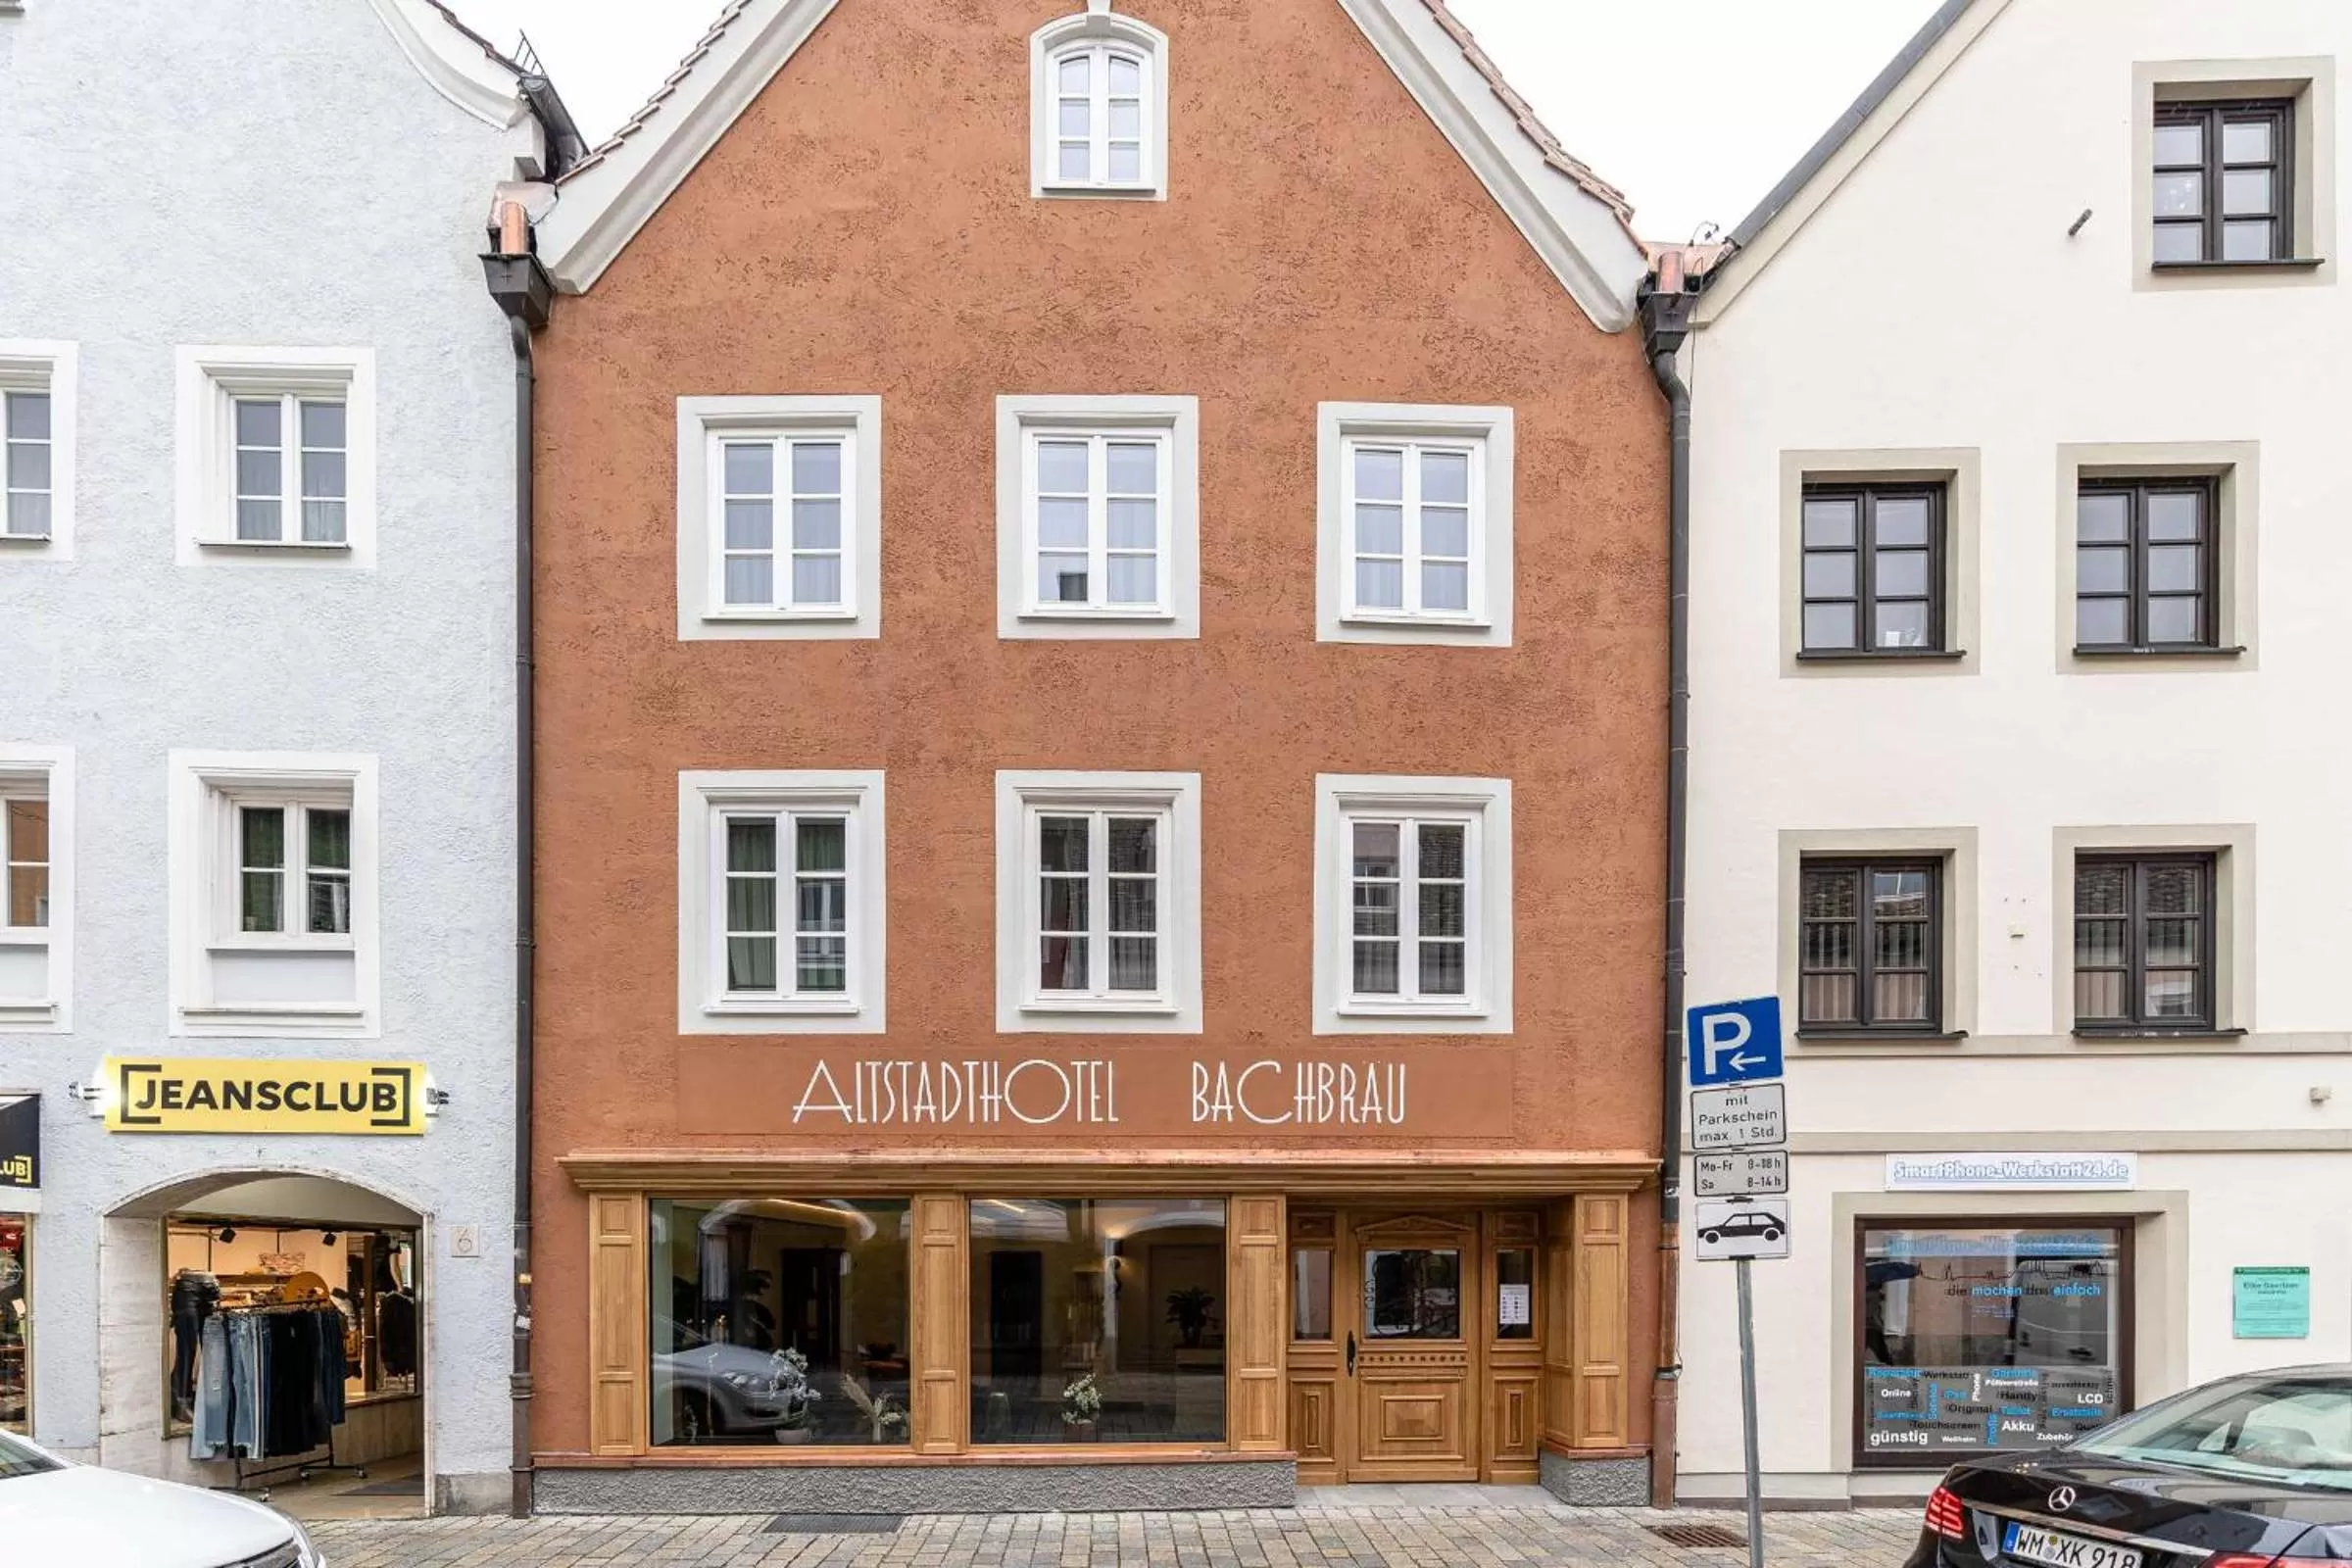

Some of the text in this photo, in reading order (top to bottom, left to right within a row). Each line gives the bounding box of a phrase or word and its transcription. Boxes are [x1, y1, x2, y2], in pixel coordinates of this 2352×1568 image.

[1702, 1012, 1752, 1075] P
[134, 1079, 398, 1112] JEANSCLUB
[793, 1059, 1119, 1123] ALTSTADTHOTEL
[1725, 1095, 1748, 1106] mit
[1698, 1110, 1778, 1126] Parkschein
[1740, 1128, 1744, 1139] 1
[1750, 1126, 1778, 1138] Std.
[1700, 1159, 1733, 1172] Mo-Fr
[1701, 1179, 1714, 1190] Sa
[2053, 1285, 2101, 1297] einfach
[1882, 1389, 1912, 1397] Online
[2078, 1394, 2103, 1403] LCD
[2002, 1420, 2034, 1431] Akku
[1870, 1431, 1928, 1446] günstig
[2017, 1529, 2045, 1555] WM
[2055, 1539, 2087, 1567] XK
